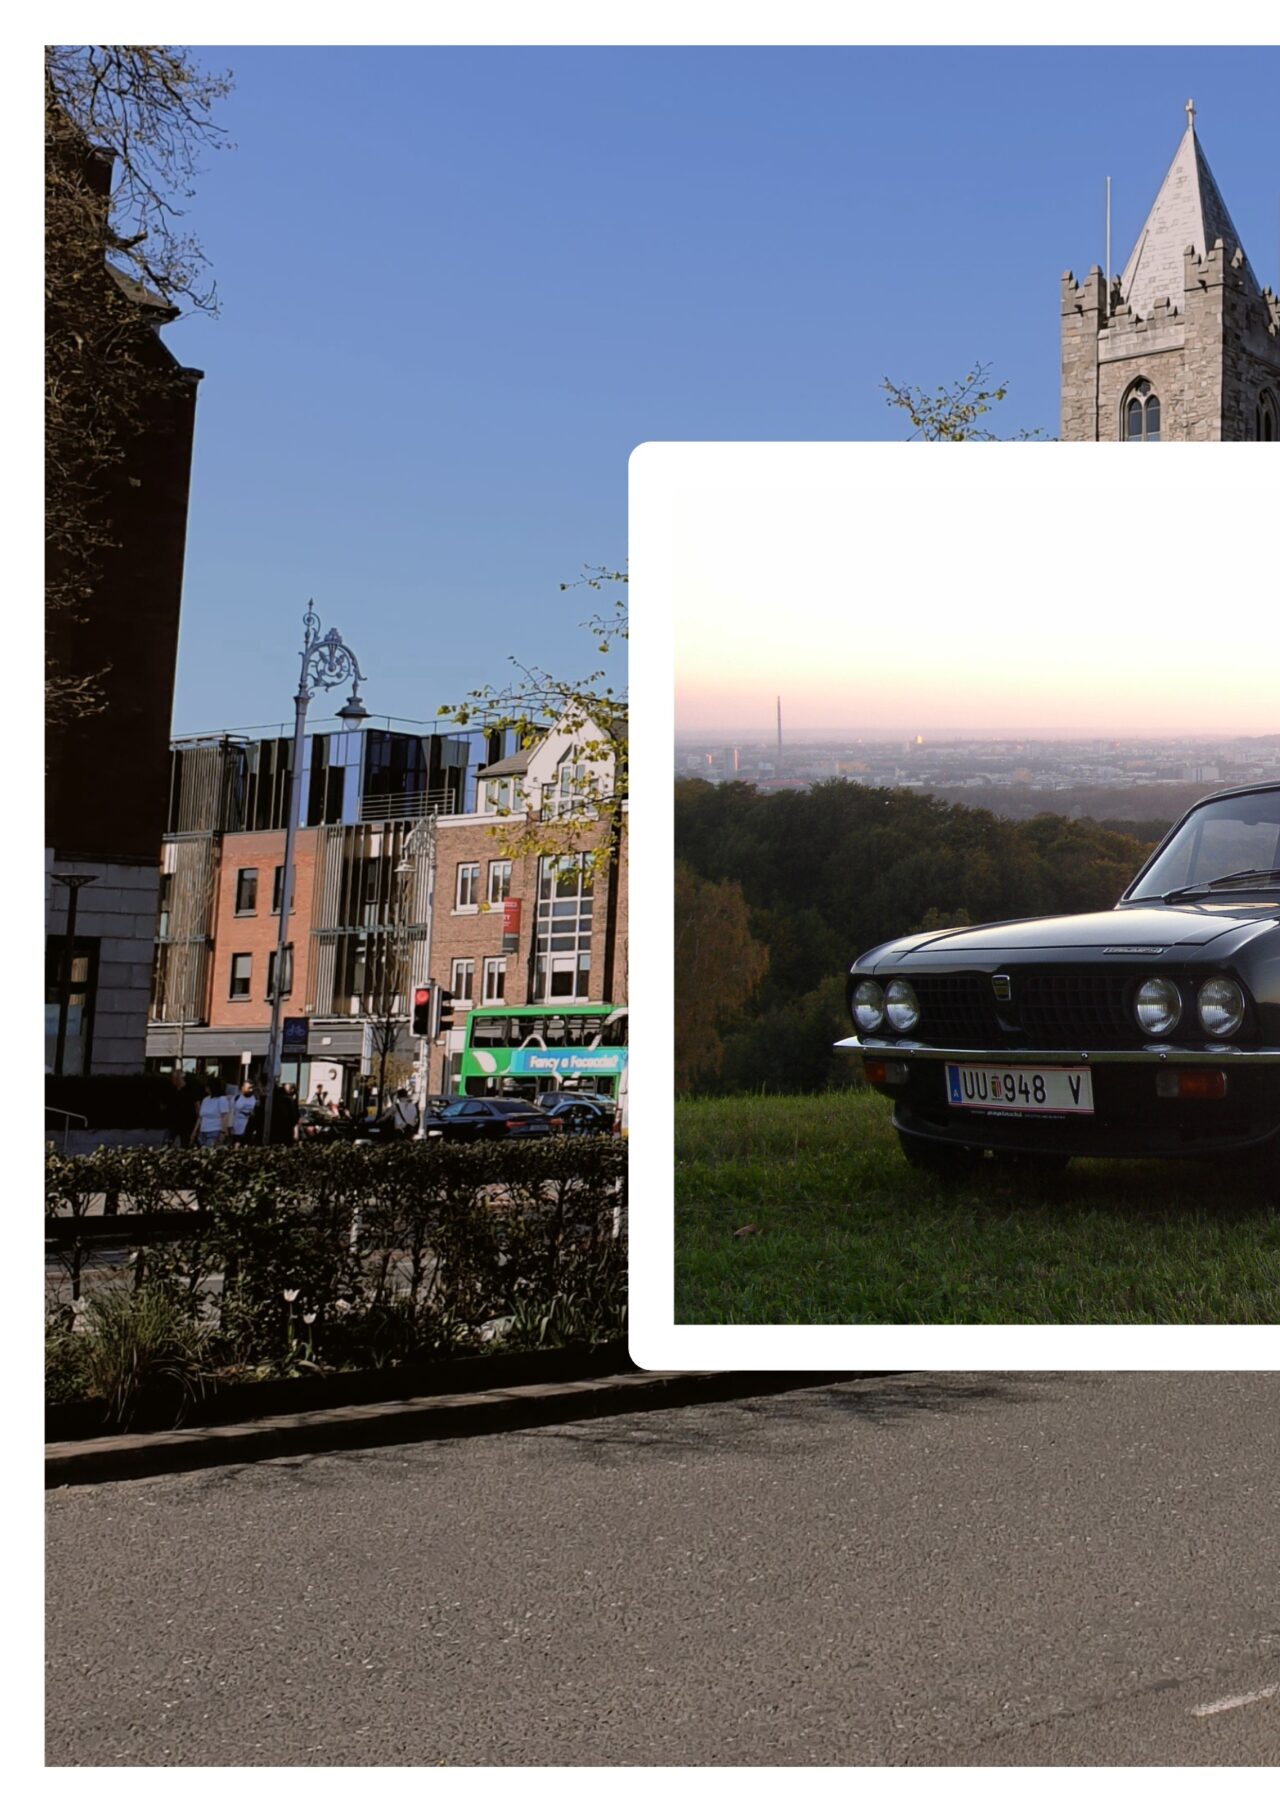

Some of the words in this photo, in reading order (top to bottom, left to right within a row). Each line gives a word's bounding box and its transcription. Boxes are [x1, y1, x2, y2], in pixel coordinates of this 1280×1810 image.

[530, 1055, 560, 1071] Fancy
[561, 1057, 568, 1068] a
[963, 1071, 988, 1100] UU
[1003, 1073, 1047, 1104] 948
[1068, 1074, 1081, 1105] V
